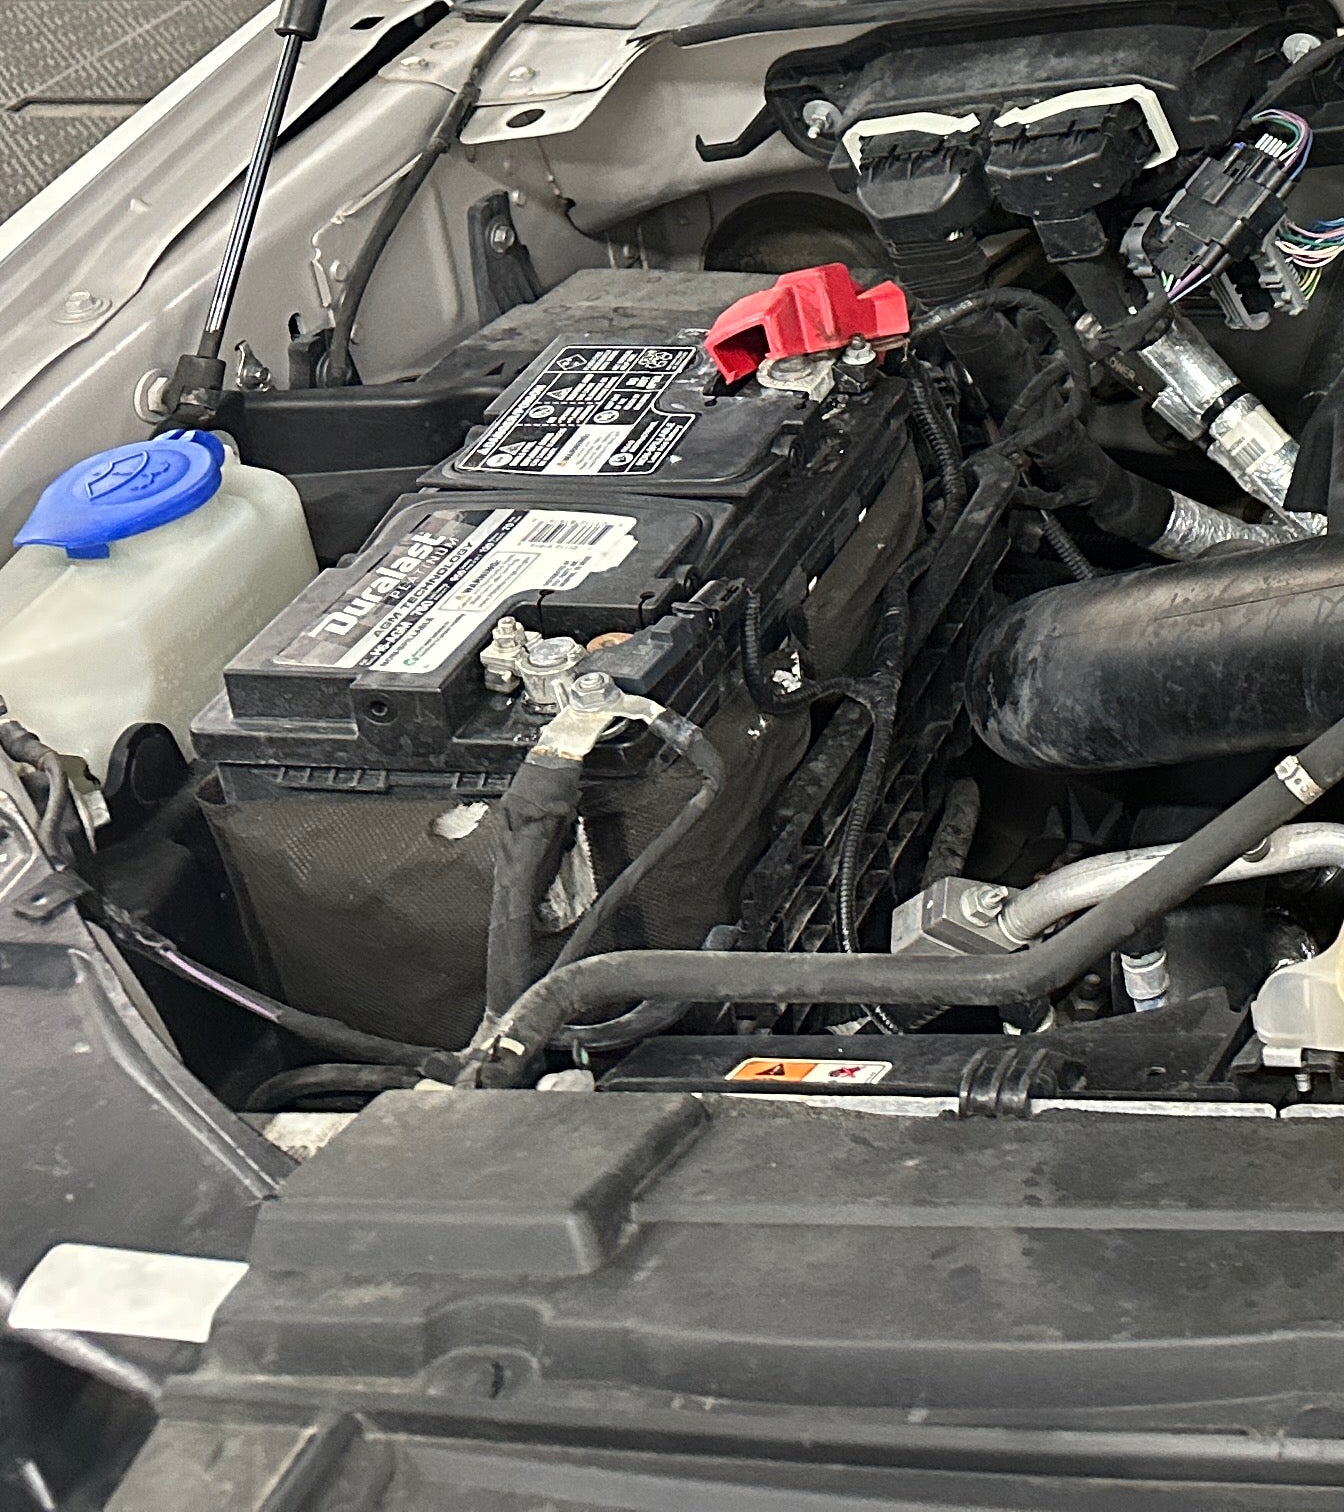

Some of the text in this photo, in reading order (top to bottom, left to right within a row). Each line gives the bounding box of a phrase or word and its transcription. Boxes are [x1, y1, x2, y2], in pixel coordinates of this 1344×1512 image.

[307, 532, 446, 637] Duralast
[373, 612, 402, 638] AGM
[400, 541, 474, 609] TECHNOLOGY
[390, 537, 459, 599] PLATINUM
